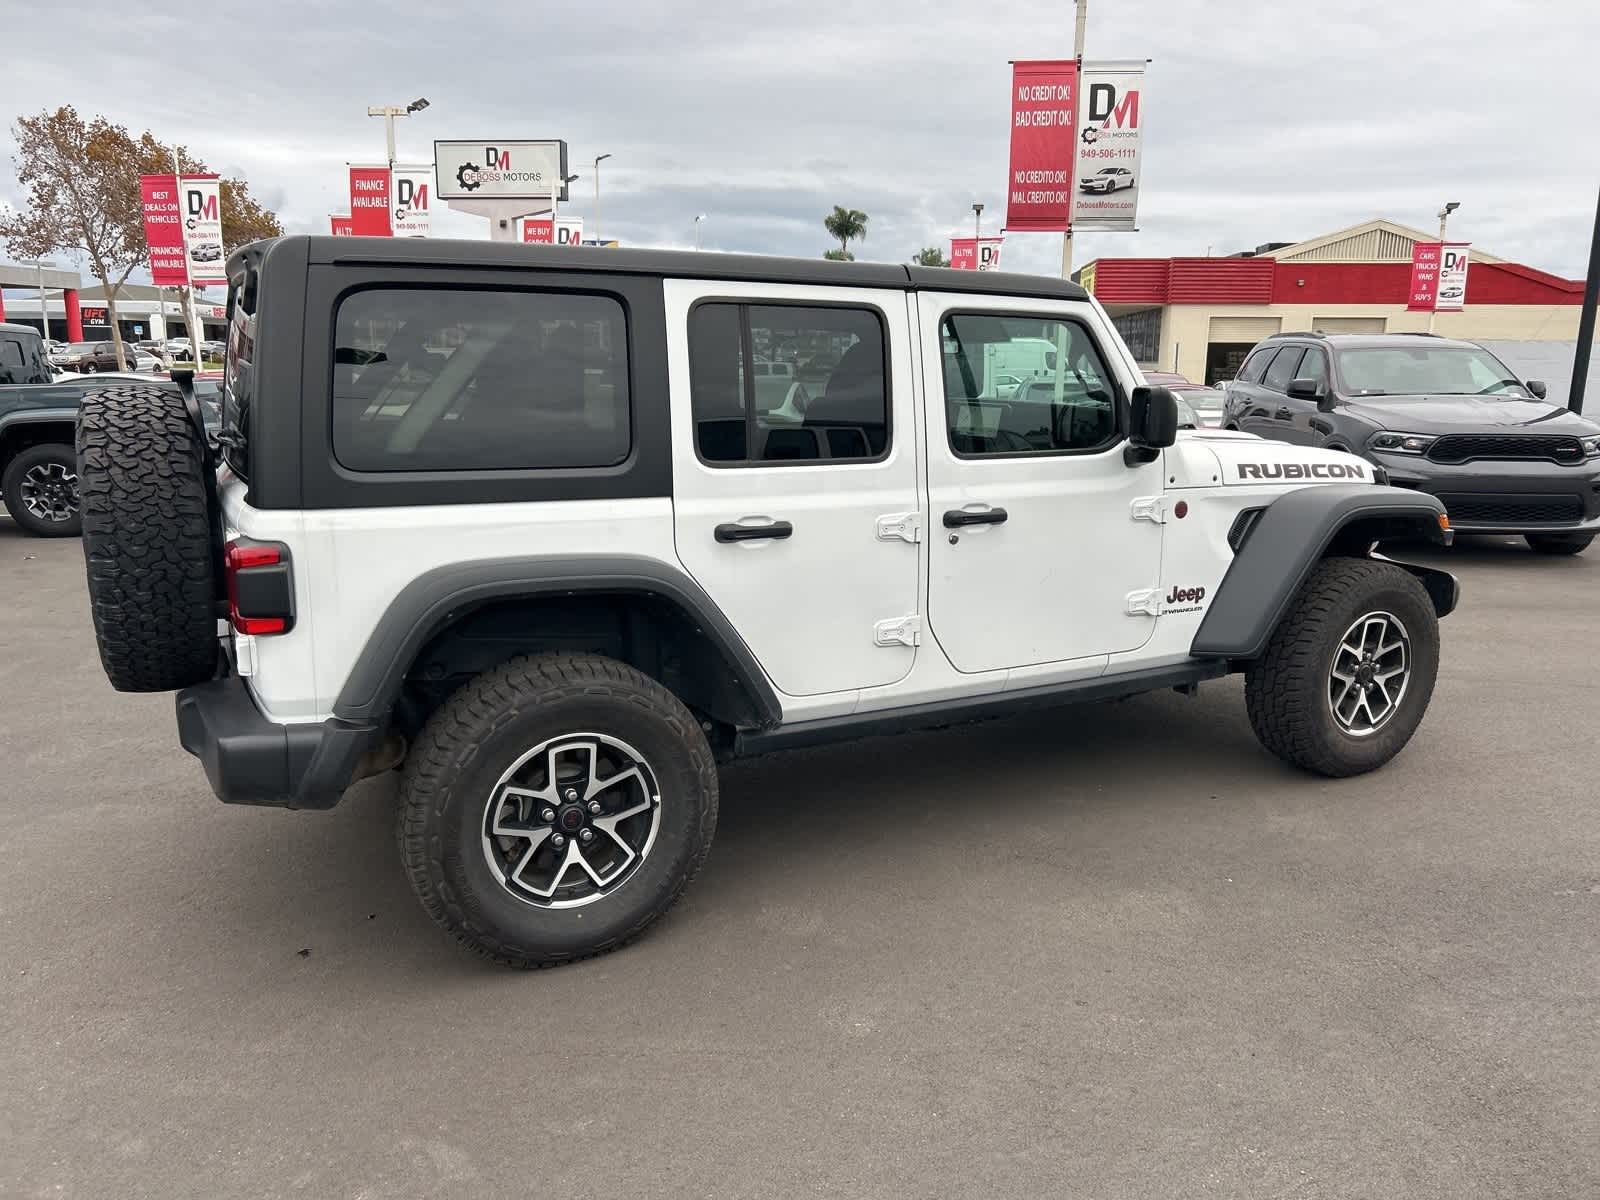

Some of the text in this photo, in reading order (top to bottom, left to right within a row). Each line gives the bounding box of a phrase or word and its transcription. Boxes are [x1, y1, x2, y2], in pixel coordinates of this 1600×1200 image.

[1018, 85, 1071, 101] NO CREDIT OK!
[1089, 83, 1139, 128] DM
[1015, 109, 1072, 127] BAD CREDIT OK!
[486, 147, 509, 170] DM
[1080, 149, 1136, 159] 949-506-1111
[464, 172, 542, 182] DEBOSS MOTORS
[1015, 170, 1067, 184] NO CREDITO OK!
[355, 180, 385, 191] FINANCE
[152, 191, 169, 200] BEST
[398, 178, 428, 211] DM
[1012, 191, 1068, 204] MAL CREDITO OK!
[145, 203, 178, 212] DEALS ON
[187, 190, 218, 221] DM
[352, 196, 388, 208] AVAILABLE
[146, 215, 179, 224] VEHICLES
[526, 227, 551, 236] WE BUY
[150, 247, 184, 255] FINANCING
[963, 248, 973, 257] TYPE
[153, 260, 184, 268] AVAILABLE
[1445, 253, 1466, 271] DM
[84, 309, 105, 318] UFC
[1237, 463, 1365, 479] RUBICON
[1166, 585, 1206, 605] Jeep
[1168, 606, 1203, 614] WRANGLER
